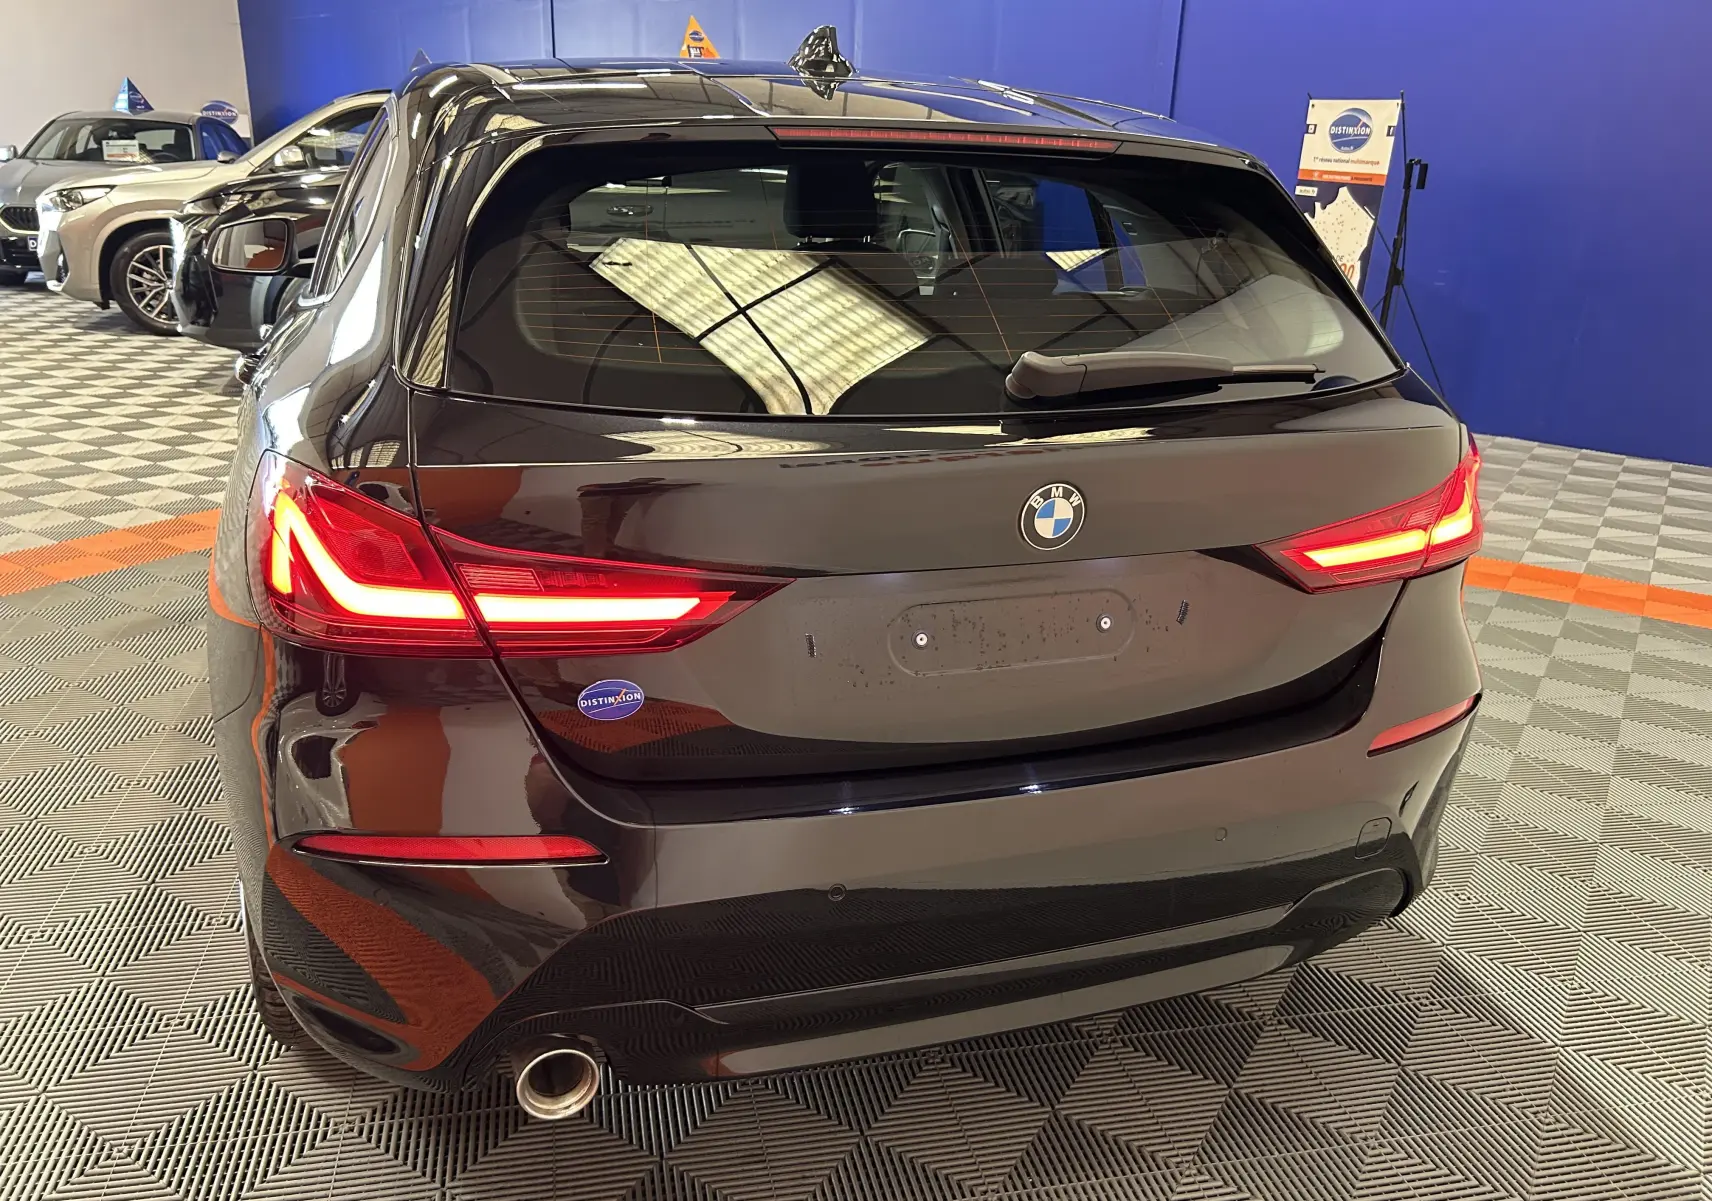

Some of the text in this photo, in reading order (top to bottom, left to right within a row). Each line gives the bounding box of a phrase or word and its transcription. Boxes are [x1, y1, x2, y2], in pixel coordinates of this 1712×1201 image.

[1330, 125, 1371, 135] DISTINXION
[1350, 159, 1380, 167] multimarque
[1030, 486, 1081, 509] BMW
[580, 692, 641, 707] DISTINXION
